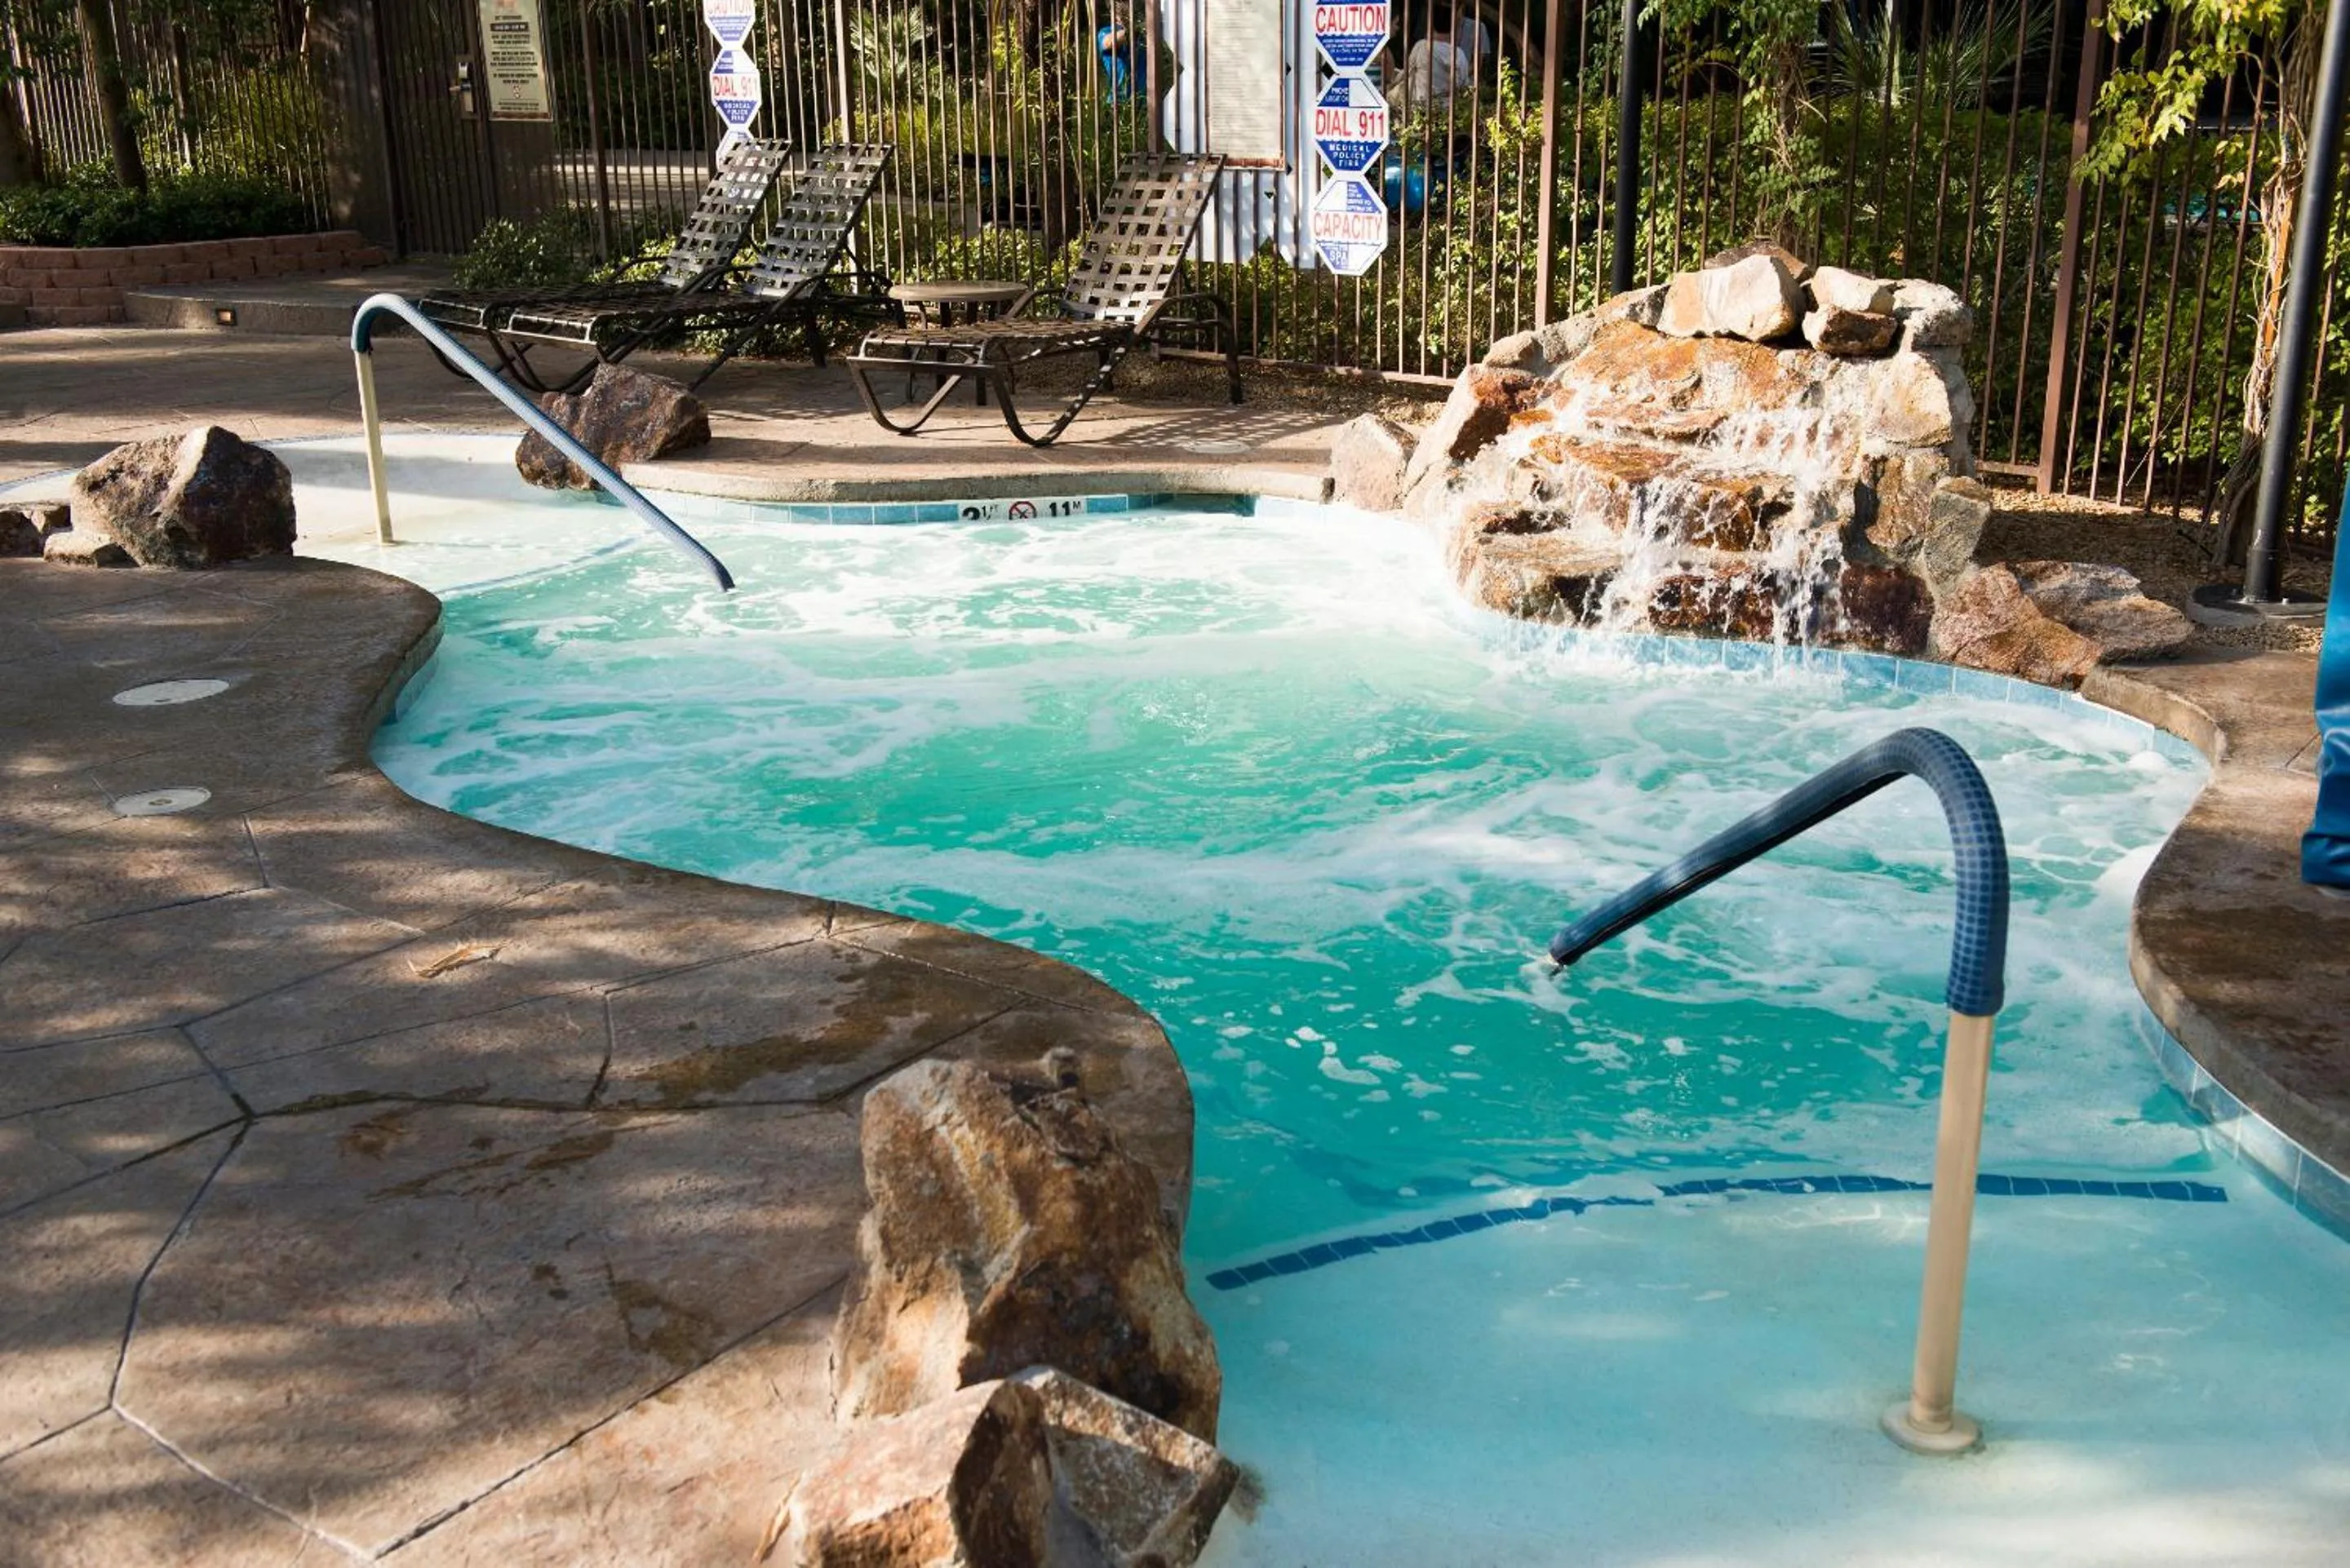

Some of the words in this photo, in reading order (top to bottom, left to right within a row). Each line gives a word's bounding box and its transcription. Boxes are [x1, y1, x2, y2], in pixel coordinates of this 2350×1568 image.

[1315, 6, 1386, 33] CAUTION
[712, 76, 738, 96] DIAL
[740, 76, 757, 97] 911
[1315, 109, 1352, 136] DIAL
[1359, 110, 1384, 138] 911
[1329, 144, 1370, 153] MEDICAL
[1332, 152, 1365, 160] POLICE
[1338, 159, 1359, 167] FIRE
[1314, 212, 1383, 240] CAPACITY
